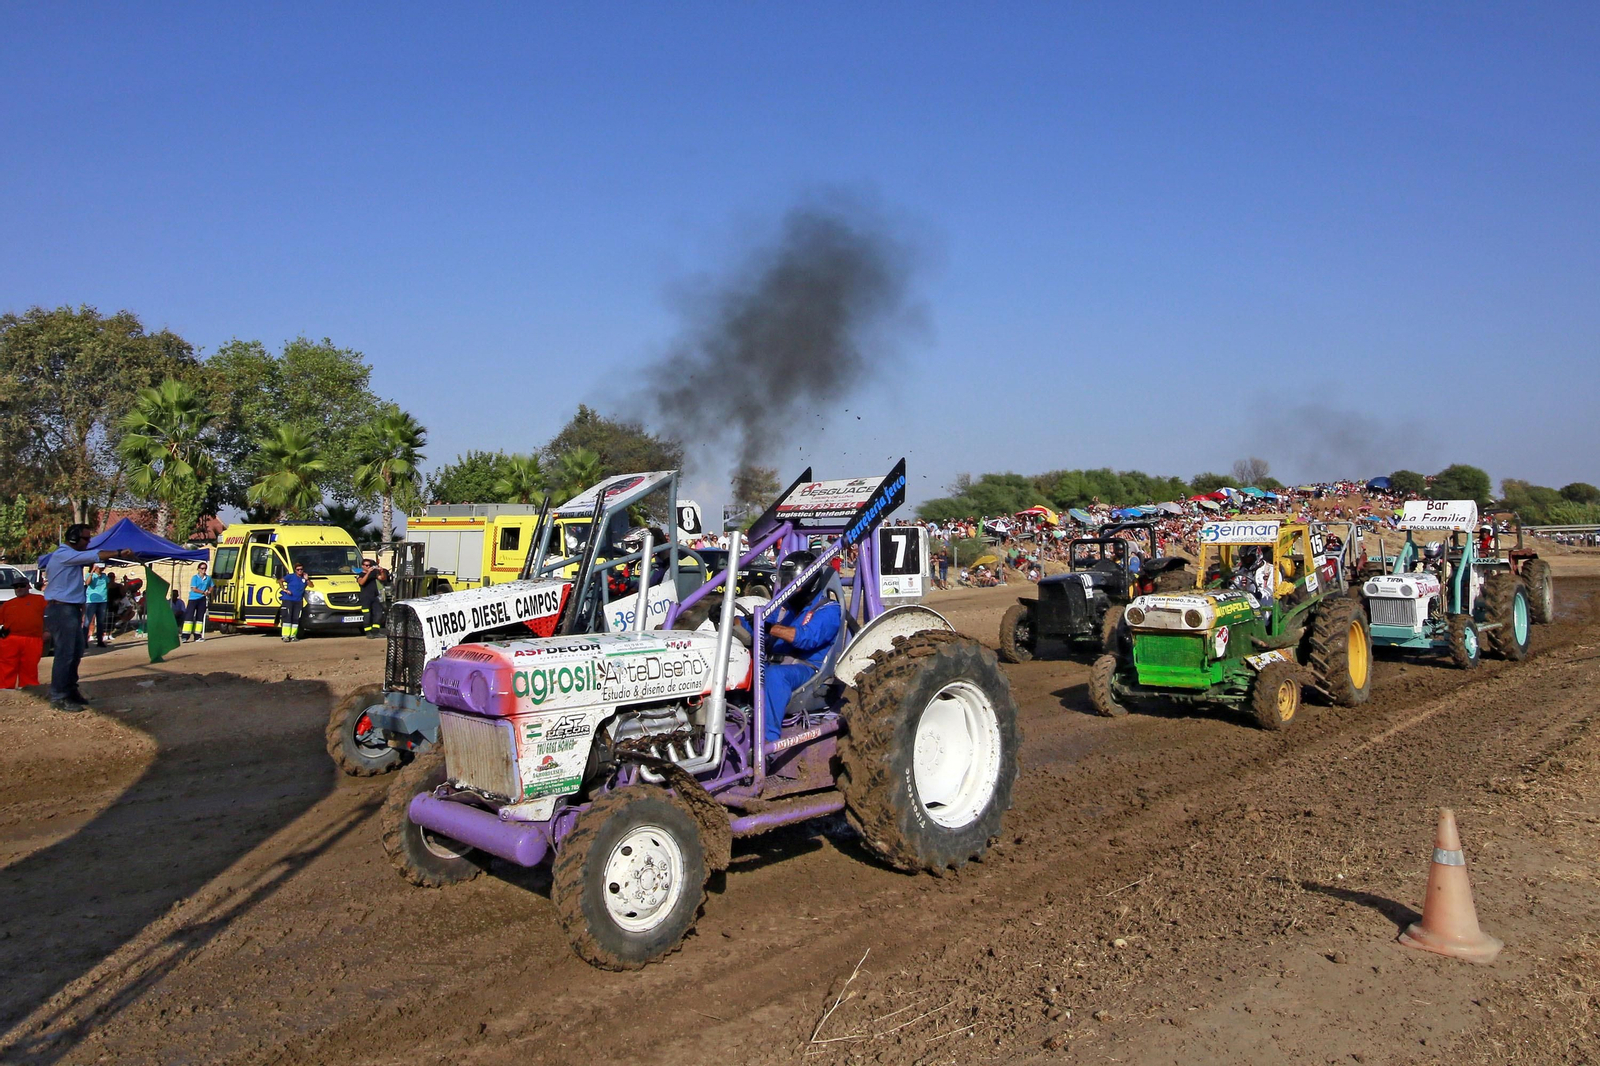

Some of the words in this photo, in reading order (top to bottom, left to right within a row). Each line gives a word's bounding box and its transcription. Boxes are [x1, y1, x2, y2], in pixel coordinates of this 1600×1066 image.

[800, 486, 877, 497] DESGUACE
[1427, 500, 1448, 510] Bar
[682, 507, 695, 531] 8
[1402, 513, 1416, 522] La
[1421, 513, 1466, 522] Familia
[1209, 525, 1279, 541] Beiman
[1357, 526, 1362, 536] 5
[891, 534, 906, 568] 7
[1311, 534, 1324, 556] 15
[426, 610, 467, 638] TURBO
[471, 602, 511, 629] DIESEL
[515, 591, 559, 619] CAMPOS
[513, 660, 596, 705] agrosil
[602, 685, 631, 701] Estudio
[633, 685, 640, 697] &
[642, 681, 665, 696] diseño
[667, 679, 676, 692] de
[678, 680, 702, 691] cocinas
